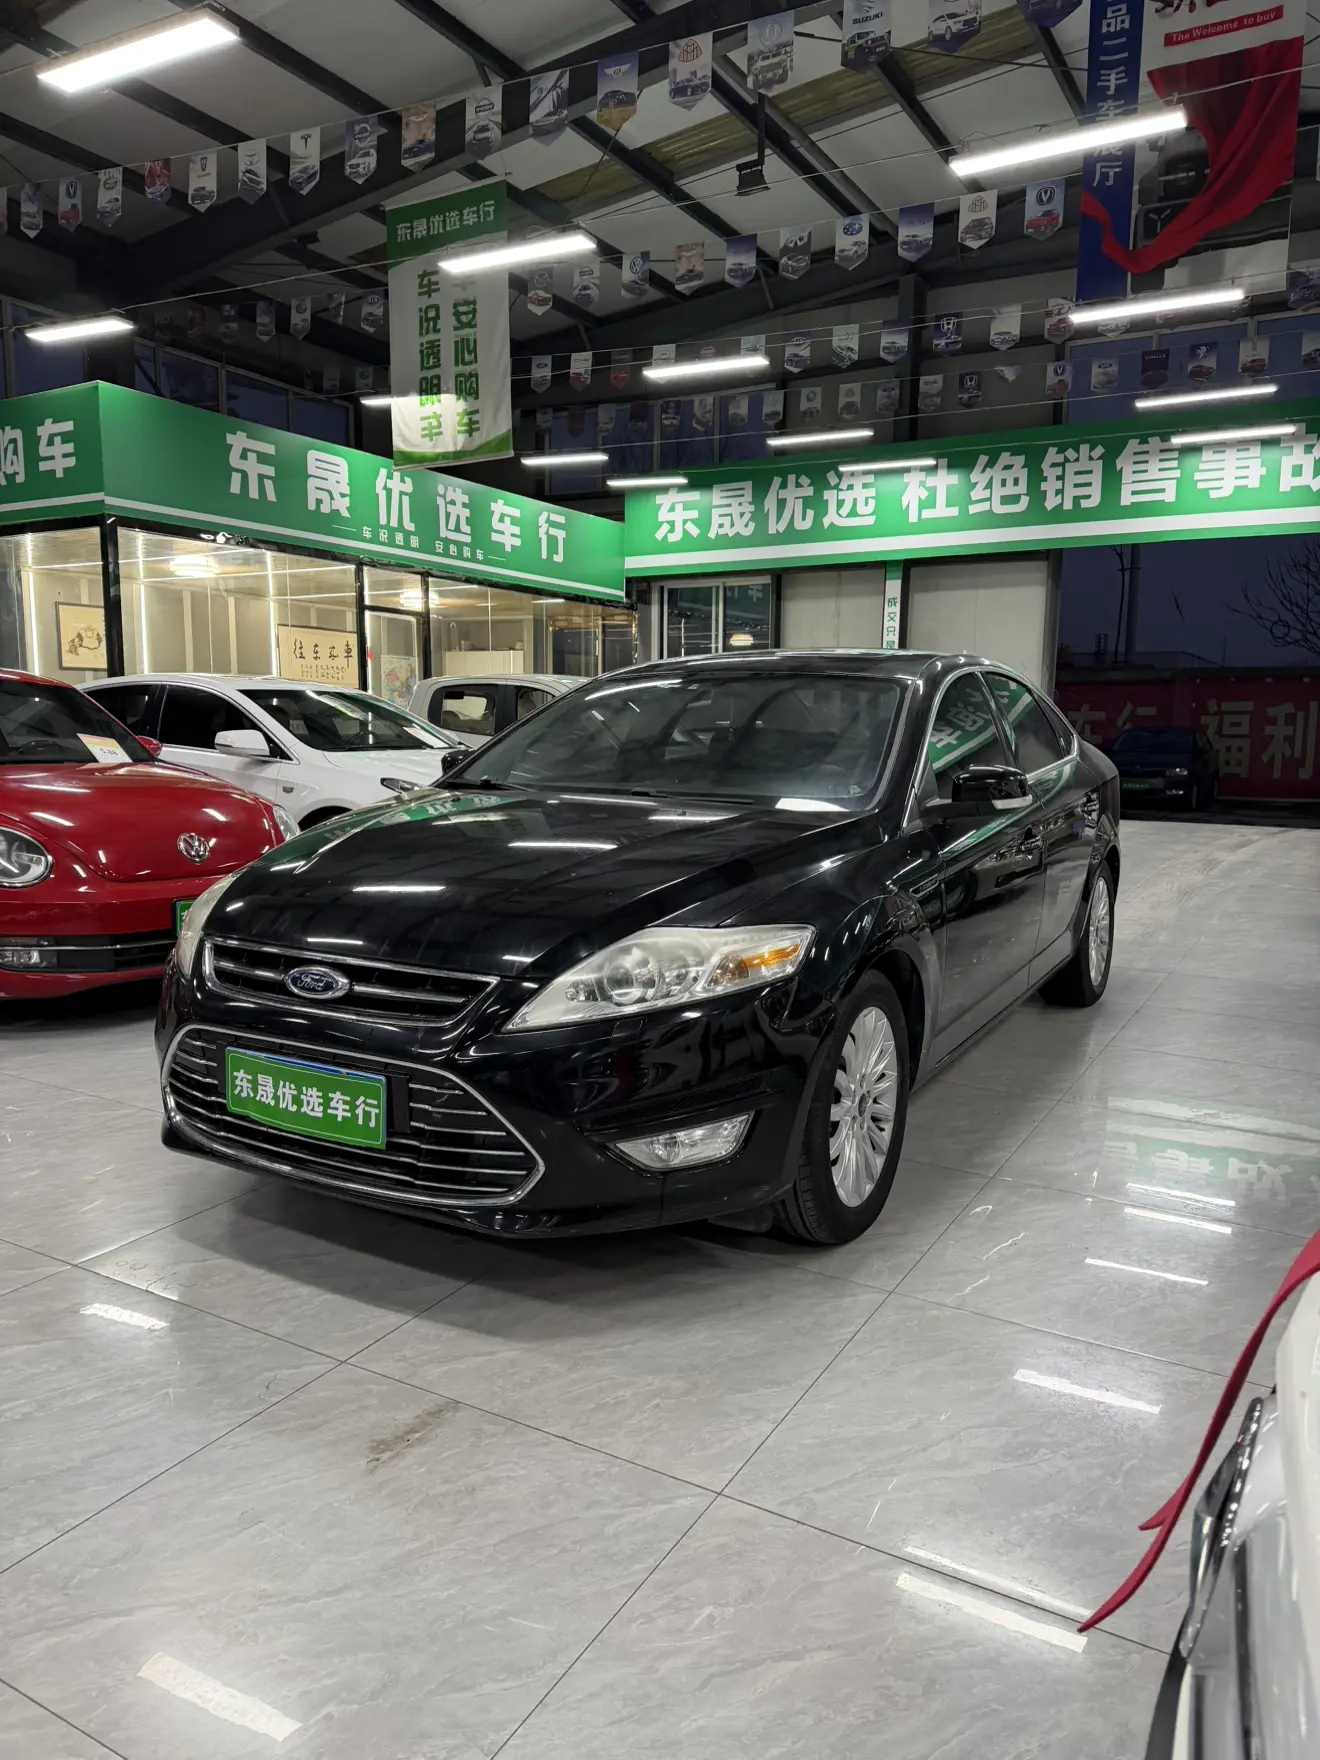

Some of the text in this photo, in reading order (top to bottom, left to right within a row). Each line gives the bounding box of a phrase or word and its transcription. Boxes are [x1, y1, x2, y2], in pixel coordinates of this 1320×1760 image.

[852, 11, 883, 25] SUZUKI
[1172, 11, 1276, 42] The Welcome to buy
[396, 200, 496, 242] 东晟优选车行
[416, 268, 442, 407] 车况透明
[452, 294, 481, 438] 安心购车
[226, 430, 566, 563] 东晟优选车行
[654, 423, 1320, 543] 东晟优选 杜绝销售事故
[362, 526, 484, 561] 车况透明 安心购车
[1200, 697, 1319, 780] 福利
[297, 973, 326, 991] Ford
[232, 1069, 380, 1129] 东晟优选车行
